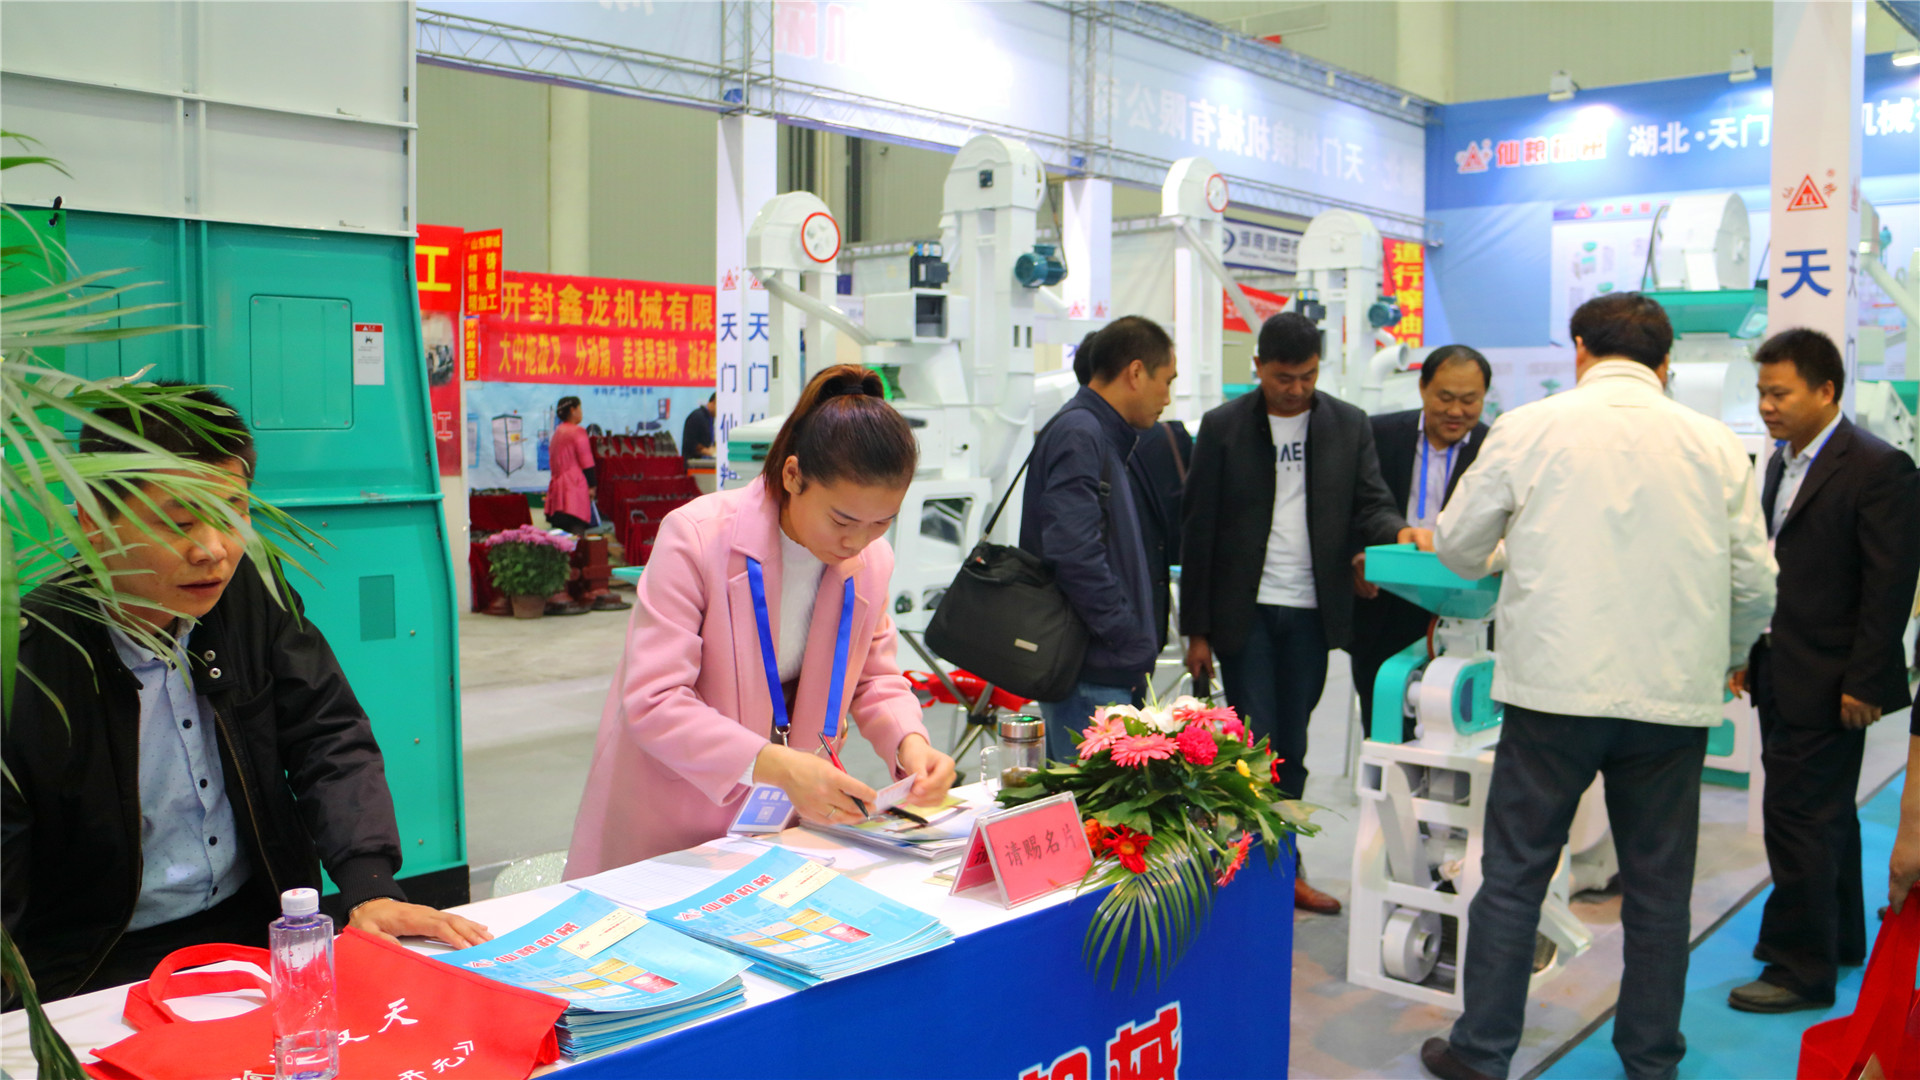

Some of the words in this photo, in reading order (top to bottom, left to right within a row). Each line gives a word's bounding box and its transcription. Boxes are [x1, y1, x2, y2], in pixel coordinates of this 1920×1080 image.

[501, 281, 716, 332] 开封鑫龙机械有限
[1005, 823, 1077, 867] 请赐名片
